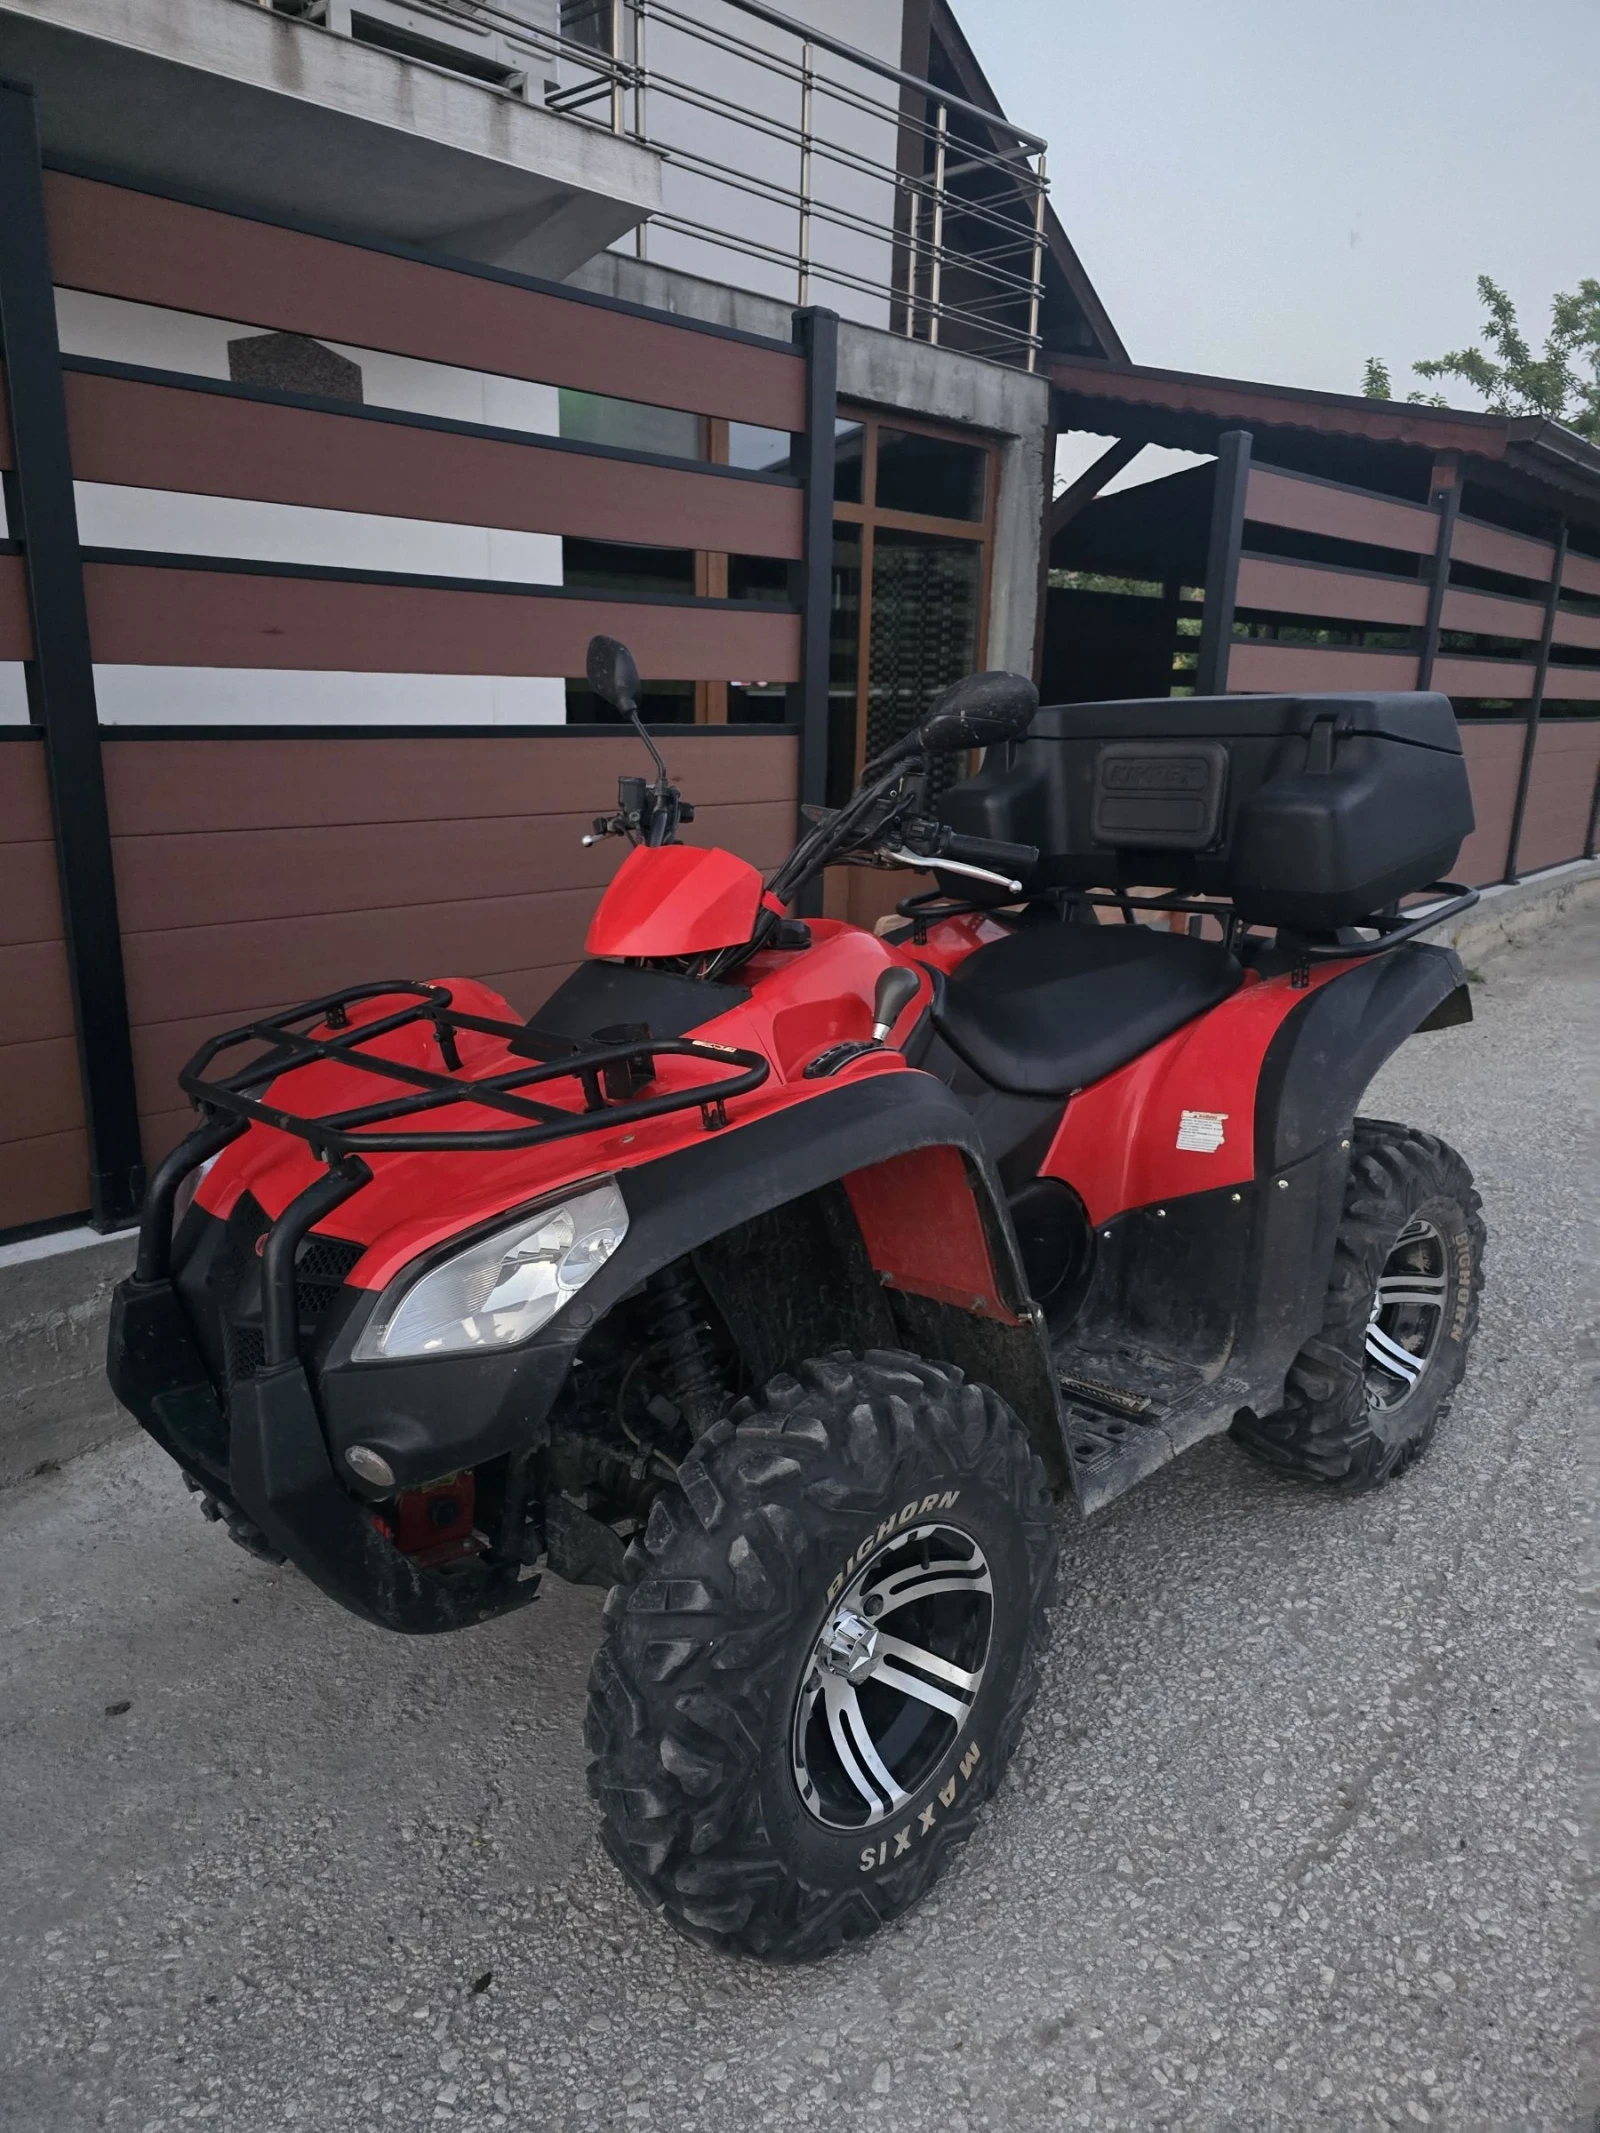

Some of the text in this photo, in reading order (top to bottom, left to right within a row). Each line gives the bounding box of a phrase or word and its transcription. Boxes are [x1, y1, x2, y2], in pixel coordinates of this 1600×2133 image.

[1451, 1232, 1471, 1342] BIGHORN
[826, 1490, 961, 1604] BIGHORN
[858, 1741, 980, 1873] MAXXIS
